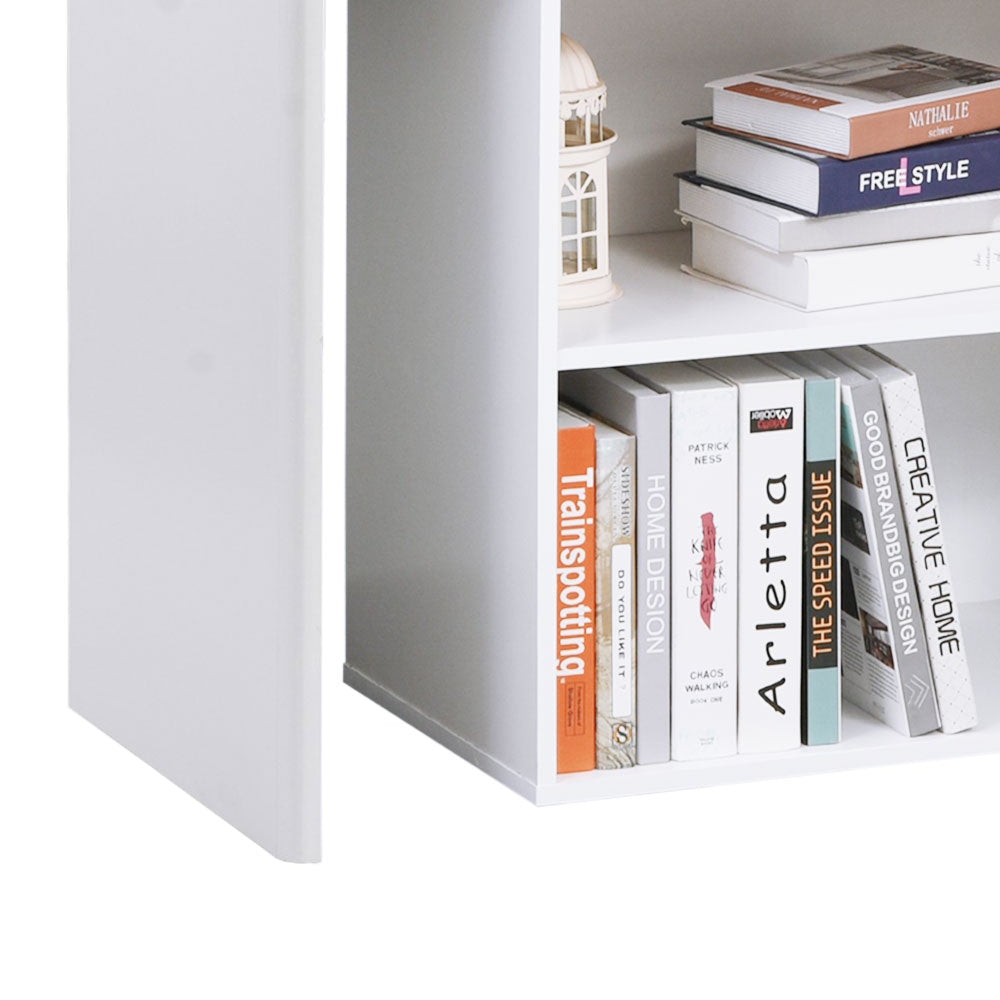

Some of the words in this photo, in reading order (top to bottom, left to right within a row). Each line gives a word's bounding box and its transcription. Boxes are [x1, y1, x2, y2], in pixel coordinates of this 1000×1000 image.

[908, 101, 970, 129] NATHALIE
[860, 168, 907, 192] FREE
[911, 159, 970, 184] STYLE
[688, 441, 730, 453] PATRICK
[694, 454, 723, 465] NESS
[863, 410, 887, 473] GOOD
[621, 465, 630, 537] SIDESHOW
[647, 475, 666, 552] HOME
[812, 470, 832, 536] ISSUE
[873, 472, 905, 576] BRANDBIG
[904, 436, 945, 571] CREATIVE
[928, 579, 960, 657] HOME
[617, 569, 625, 590] DO
[812, 539, 832, 609] SPEED
[617, 596, 625, 624] YOU
[755, 473, 788, 716] Arletta
[893, 577, 918, 656] DESIGN
[617, 629, 626, 660] LIKE
[812, 616, 832, 658] THE
[618, 665, 626, 678] IT
[685, 681, 729, 692] WALKING
[689, 669, 724, 680] CHAOS
